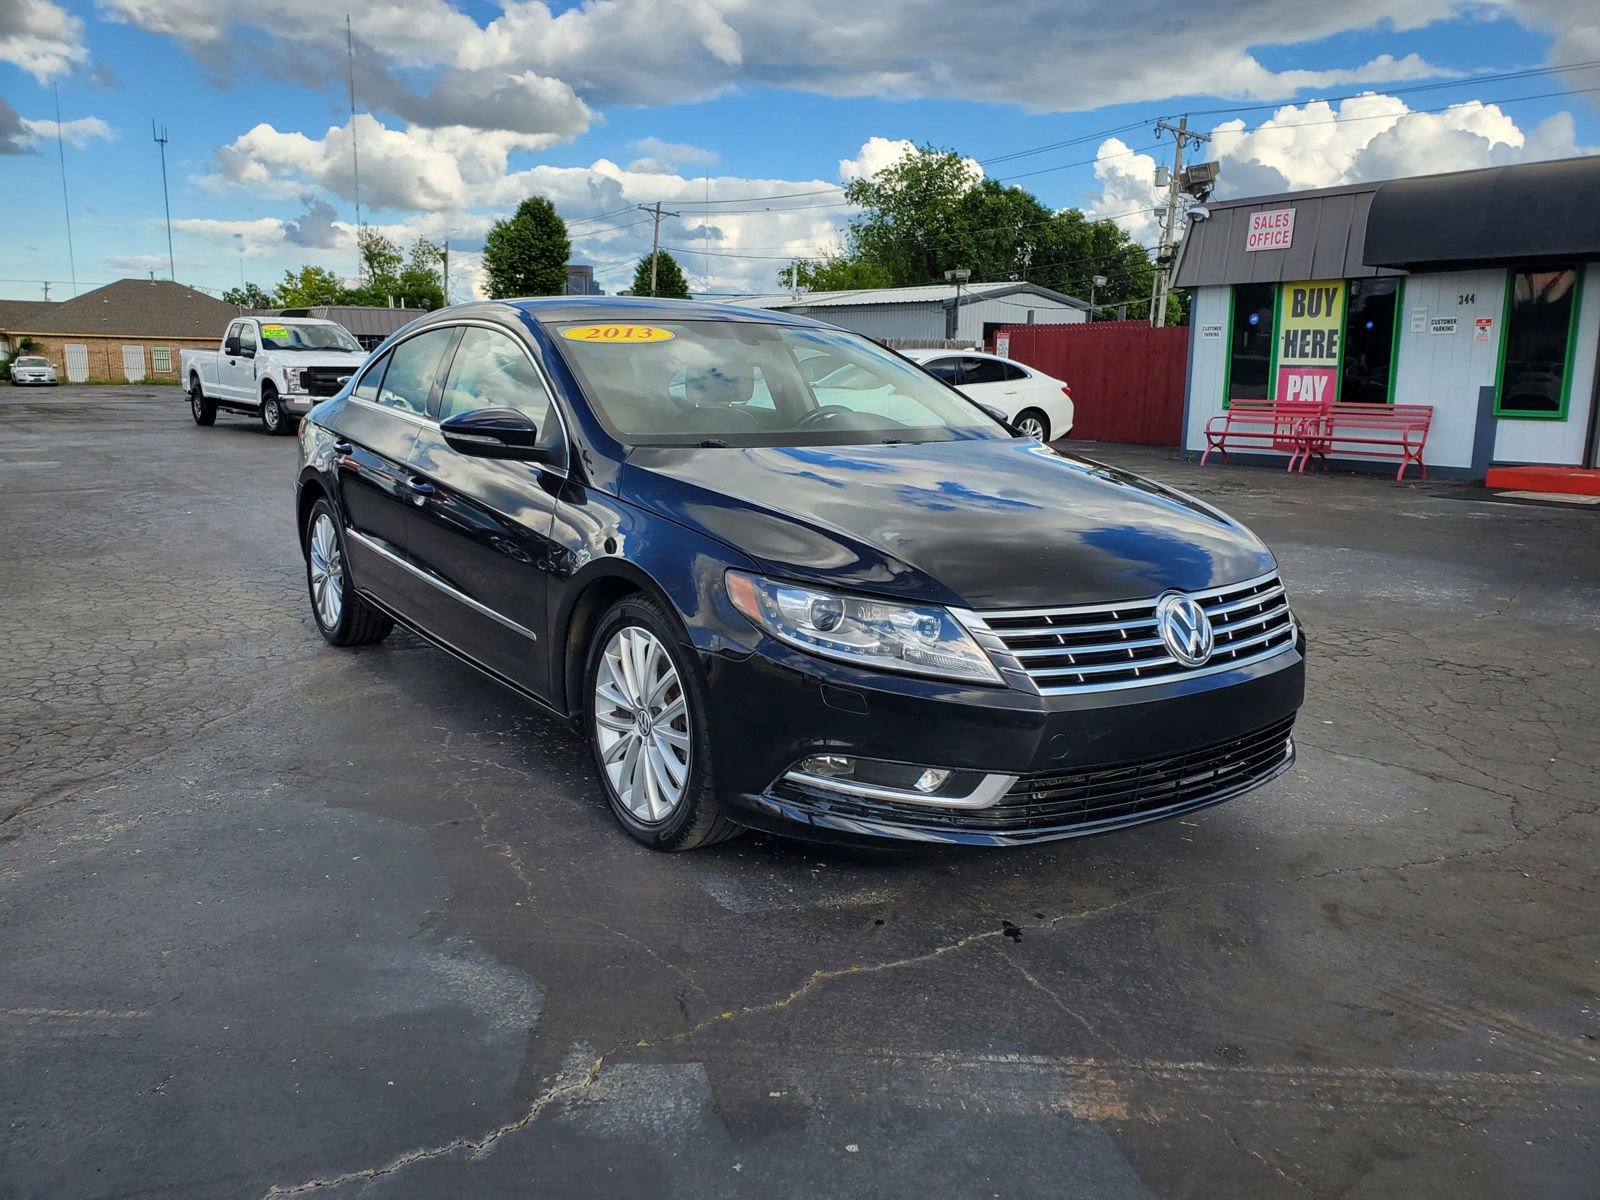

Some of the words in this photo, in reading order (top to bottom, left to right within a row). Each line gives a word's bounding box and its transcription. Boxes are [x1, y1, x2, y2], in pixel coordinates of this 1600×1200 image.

[1253, 213, 1289, 230] SALES
[1249, 230, 1289, 247] OFFICE
[1291, 287, 1339, 318] BUY
[1458, 293, 1475, 305] 344
[585, 327, 654, 339] 2013
[1283, 329, 1339, 358] HERE
[1286, 375, 1328, 401] PAY
